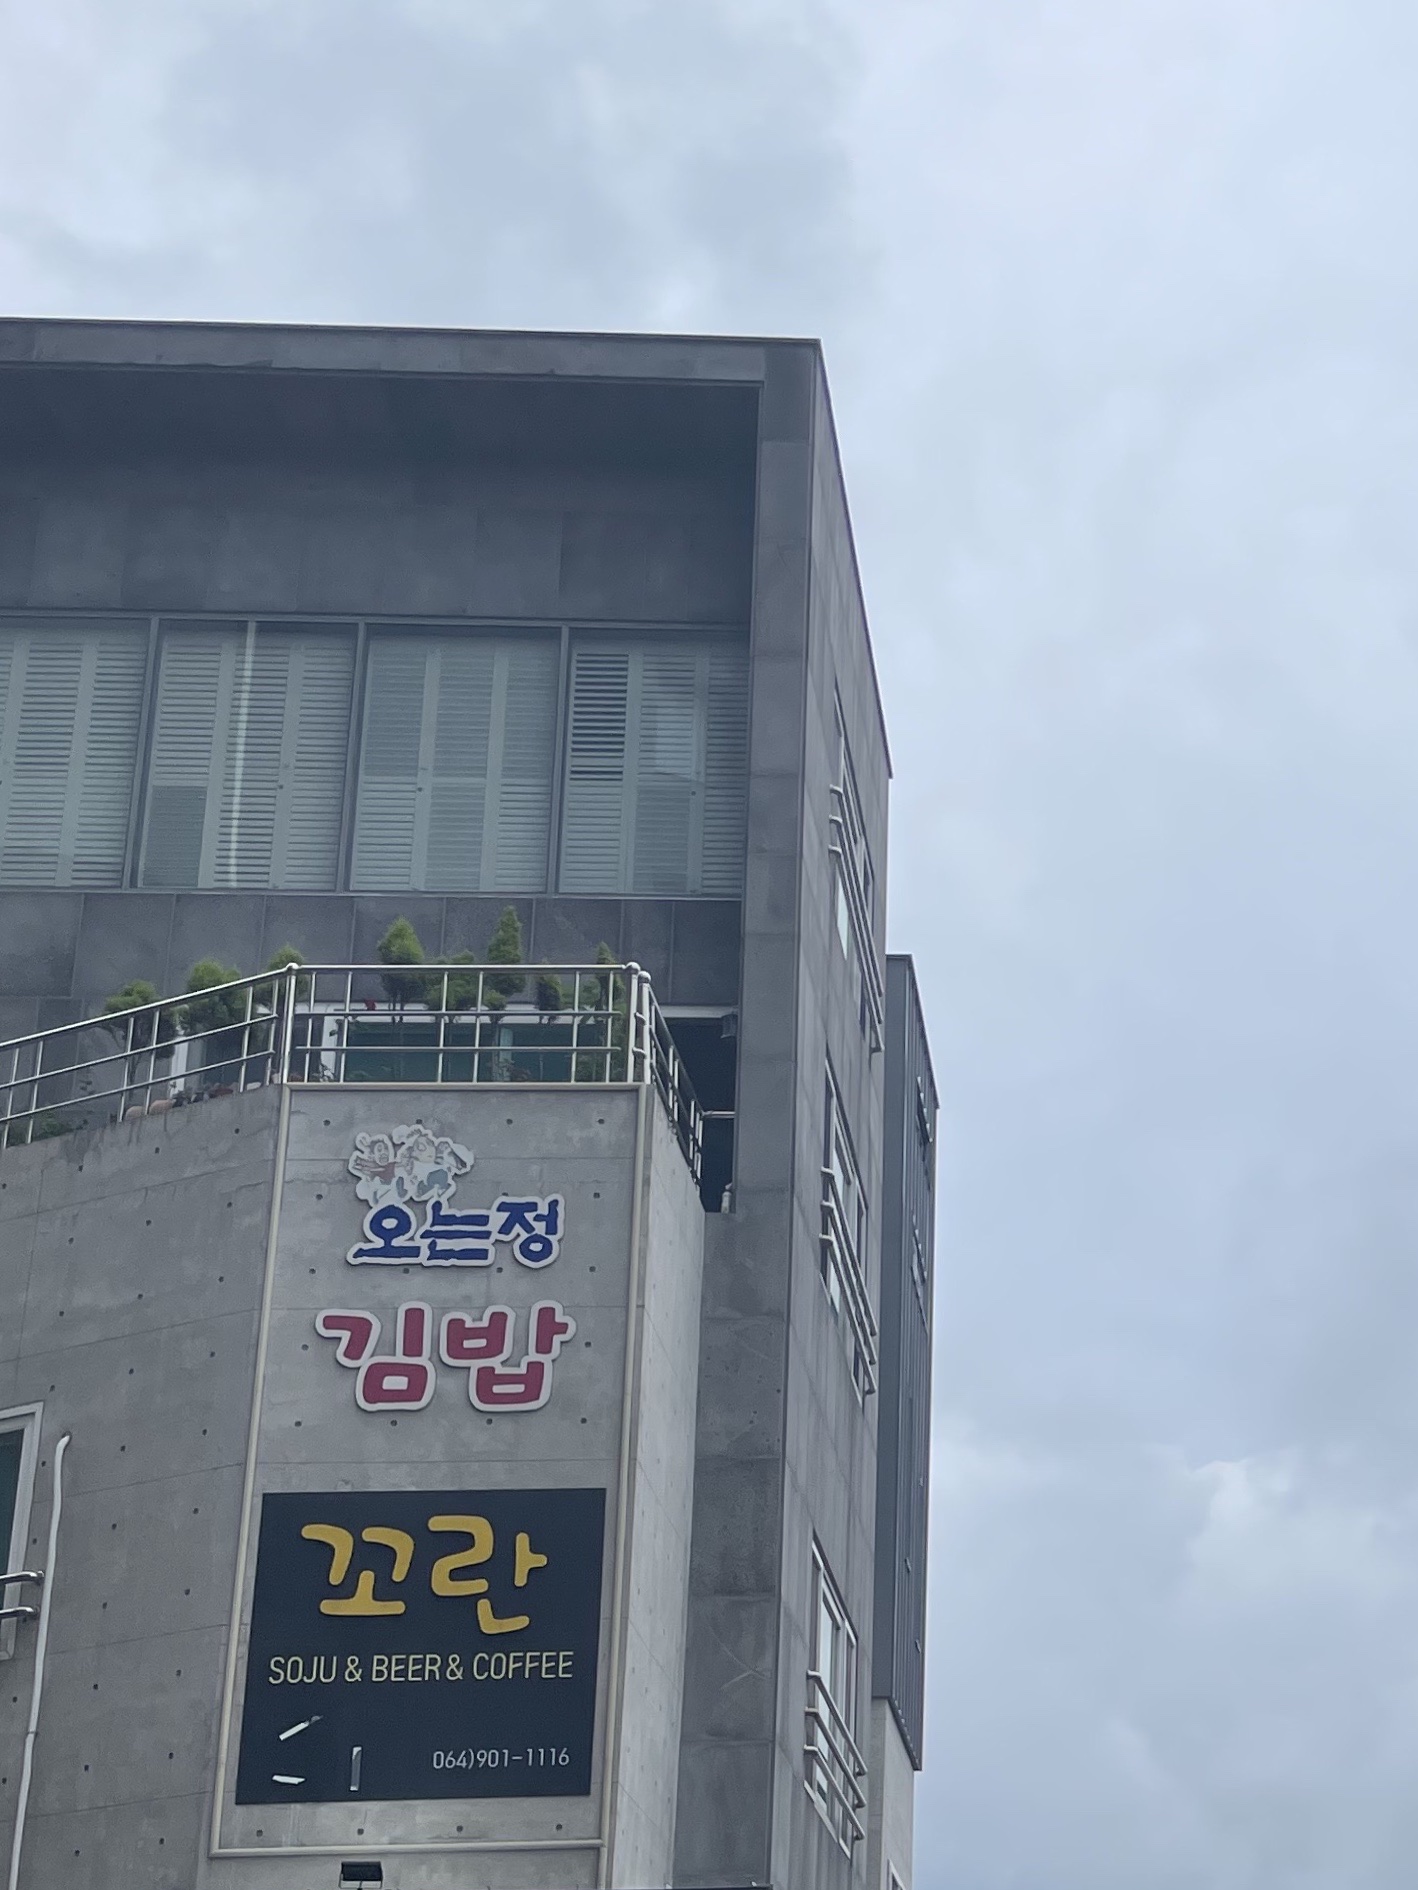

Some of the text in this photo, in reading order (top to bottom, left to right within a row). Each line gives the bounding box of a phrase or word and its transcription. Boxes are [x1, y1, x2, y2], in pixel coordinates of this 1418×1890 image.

[351, 1198, 560, 1263] 오는정
[322, 1306, 569, 1405] 김밥
[301, 1515, 548, 1634] 꼬란
[268, 1655, 338, 1685] SOJU
[344, 1655, 363, 1682] &
[472, 1651, 575, 1680] COFFEE
[432, 1747, 570, 1770] 064)901-1116
